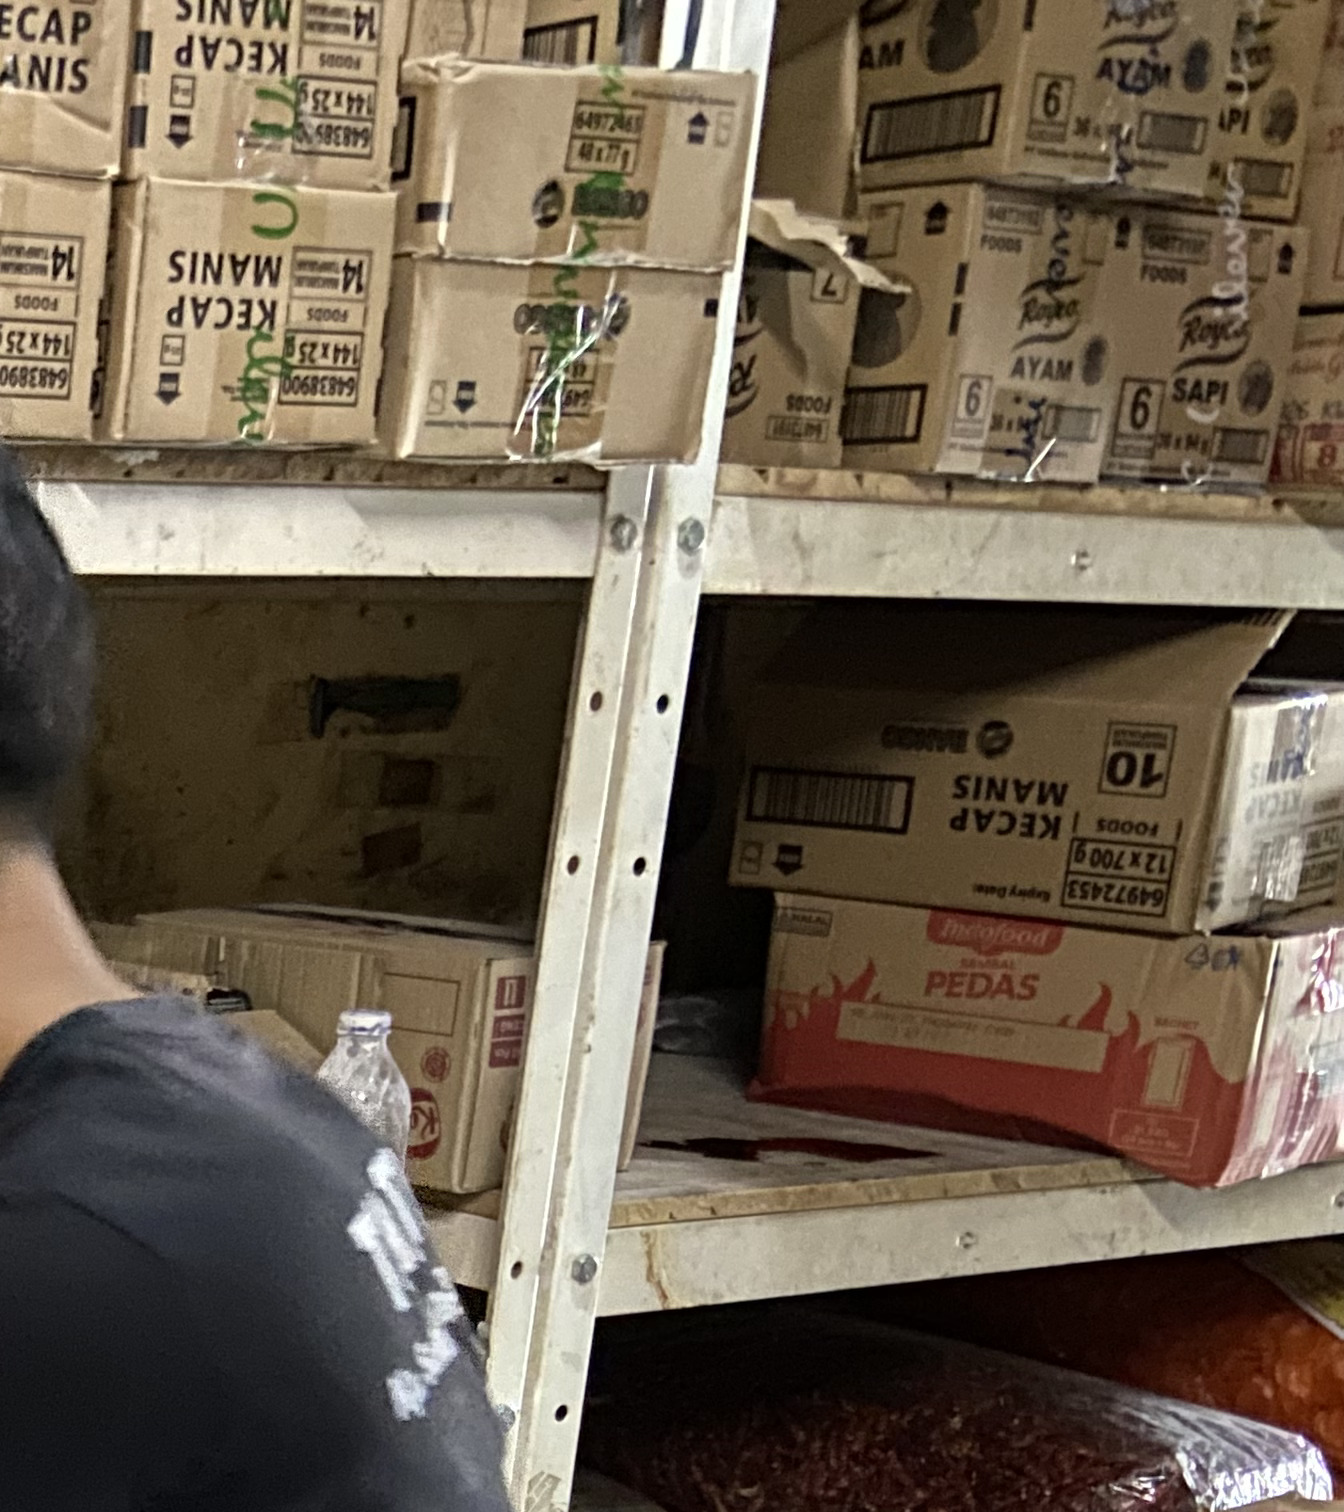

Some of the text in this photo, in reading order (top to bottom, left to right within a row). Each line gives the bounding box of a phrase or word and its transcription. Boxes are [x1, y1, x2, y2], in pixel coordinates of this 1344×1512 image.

[354, 7, 376, 41] 14
[174, 34, 288, 76] KECAP
[1043, 80, 1062, 119] 6
[52, 244, 76, 282] 14
[167, 249, 282, 287] MANIS
[341, 258, 365, 295] 14
[14, 294, 58, 312] FOODS
[166, 295, 278, 331] KECAP
[306, 307, 349, 324] FOODS
[7, 331, 25, 354] 25
[28, 332, 40, 350] x
[43, 332, 71, 357] 144
[298, 340, 318, 362] 25
[321, 342, 331, 359] x
[332, 342, 360, 366] 144
[1011, 355, 1074, 382] AYAM
[281, 373, 356, 397] 64838900
[963, 378, 982, 418] 6
[1171, 377, 1229, 405] SAPI
[1129, 385, 1153, 432] 6
[1105, 750, 1164, 789] 10
[952, 773, 1069, 807] MANIS
[949, 808, 1062, 841] KECAP
[1095, 817, 1159, 837] FOODS
[1072, 839, 1168, 875] 12 x 700 g
[1066, 878, 1165, 909] 64972453
[924, 970, 1040, 1001] PEDAS
